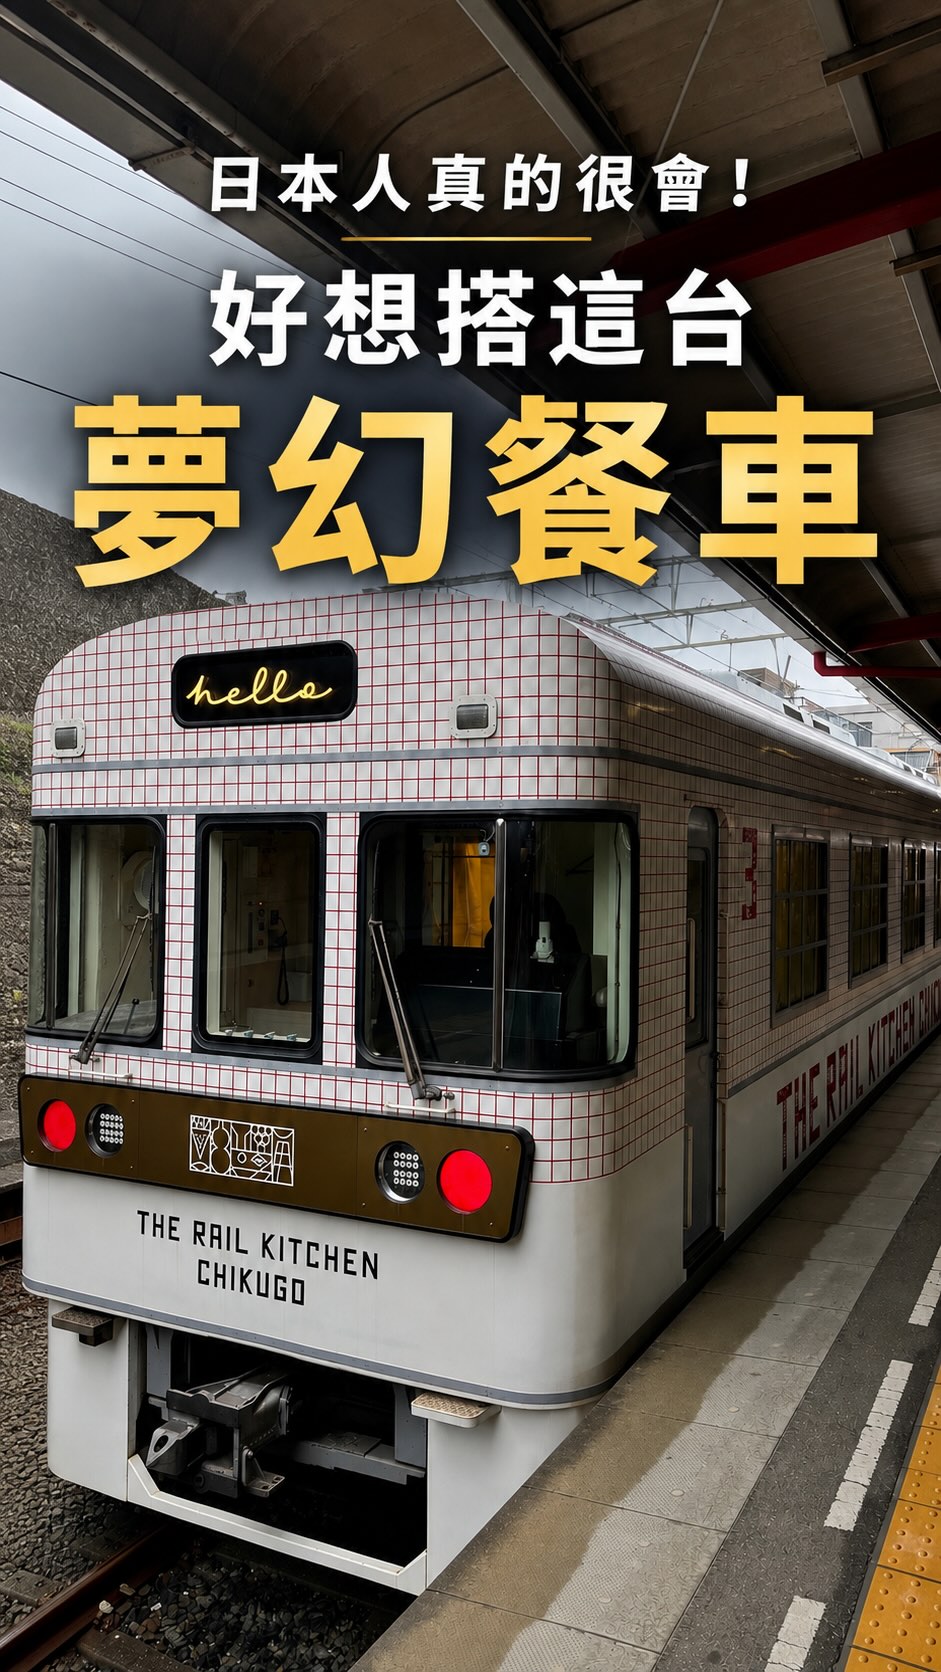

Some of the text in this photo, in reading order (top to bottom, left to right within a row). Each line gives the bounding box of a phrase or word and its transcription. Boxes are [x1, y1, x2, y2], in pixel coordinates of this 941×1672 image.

[186, 667, 333, 705] hello
[742, 827, 758, 921] 3
[776, 1062, 820, 1172] THE
[825, 1034, 863, 1129] RAIL
[868, 996, 915, 1086] KITCHEN
[137, 1210, 378, 1280] THE RAIL KITCHEN
[197, 1259, 305, 1306] CHIKUGO
